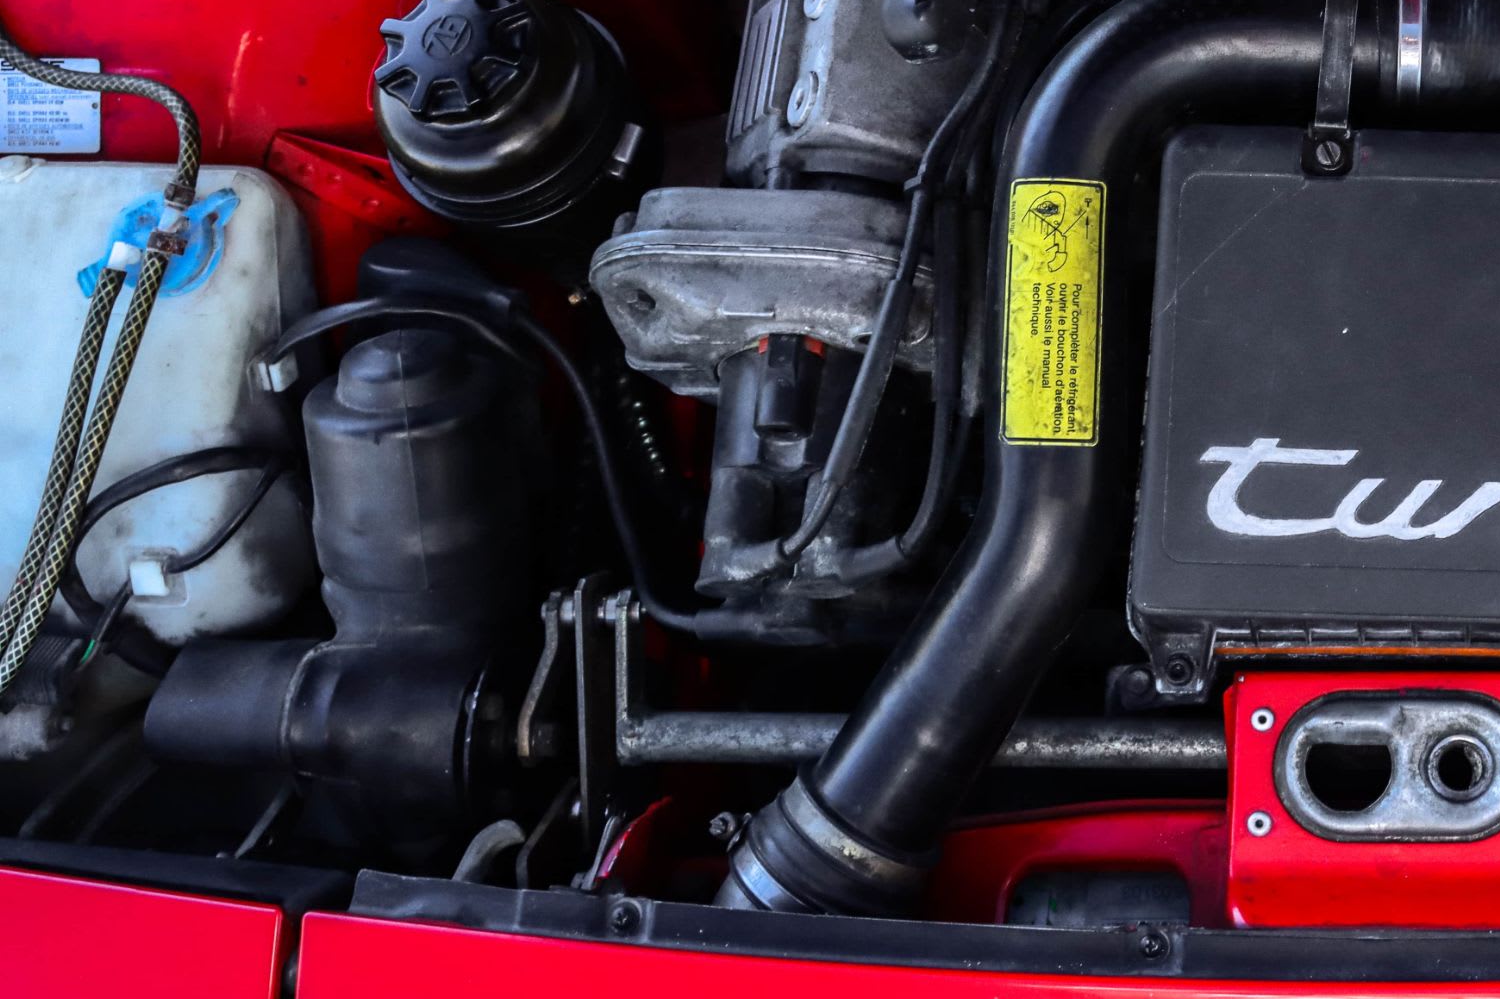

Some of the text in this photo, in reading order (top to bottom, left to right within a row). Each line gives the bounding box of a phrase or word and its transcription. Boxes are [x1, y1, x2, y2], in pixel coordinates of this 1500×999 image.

[1030, 282, 1041, 338] technique.
[1058, 283, 1068, 313] ouvrir
[1072, 283, 1082, 308] Pour
[1042, 282, 1056, 389] Voir aussi le manual
[1058, 316, 1067, 326] le
[1056, 329, 1068, 376] bouchon
[1070, 366, 1079, 375] le
